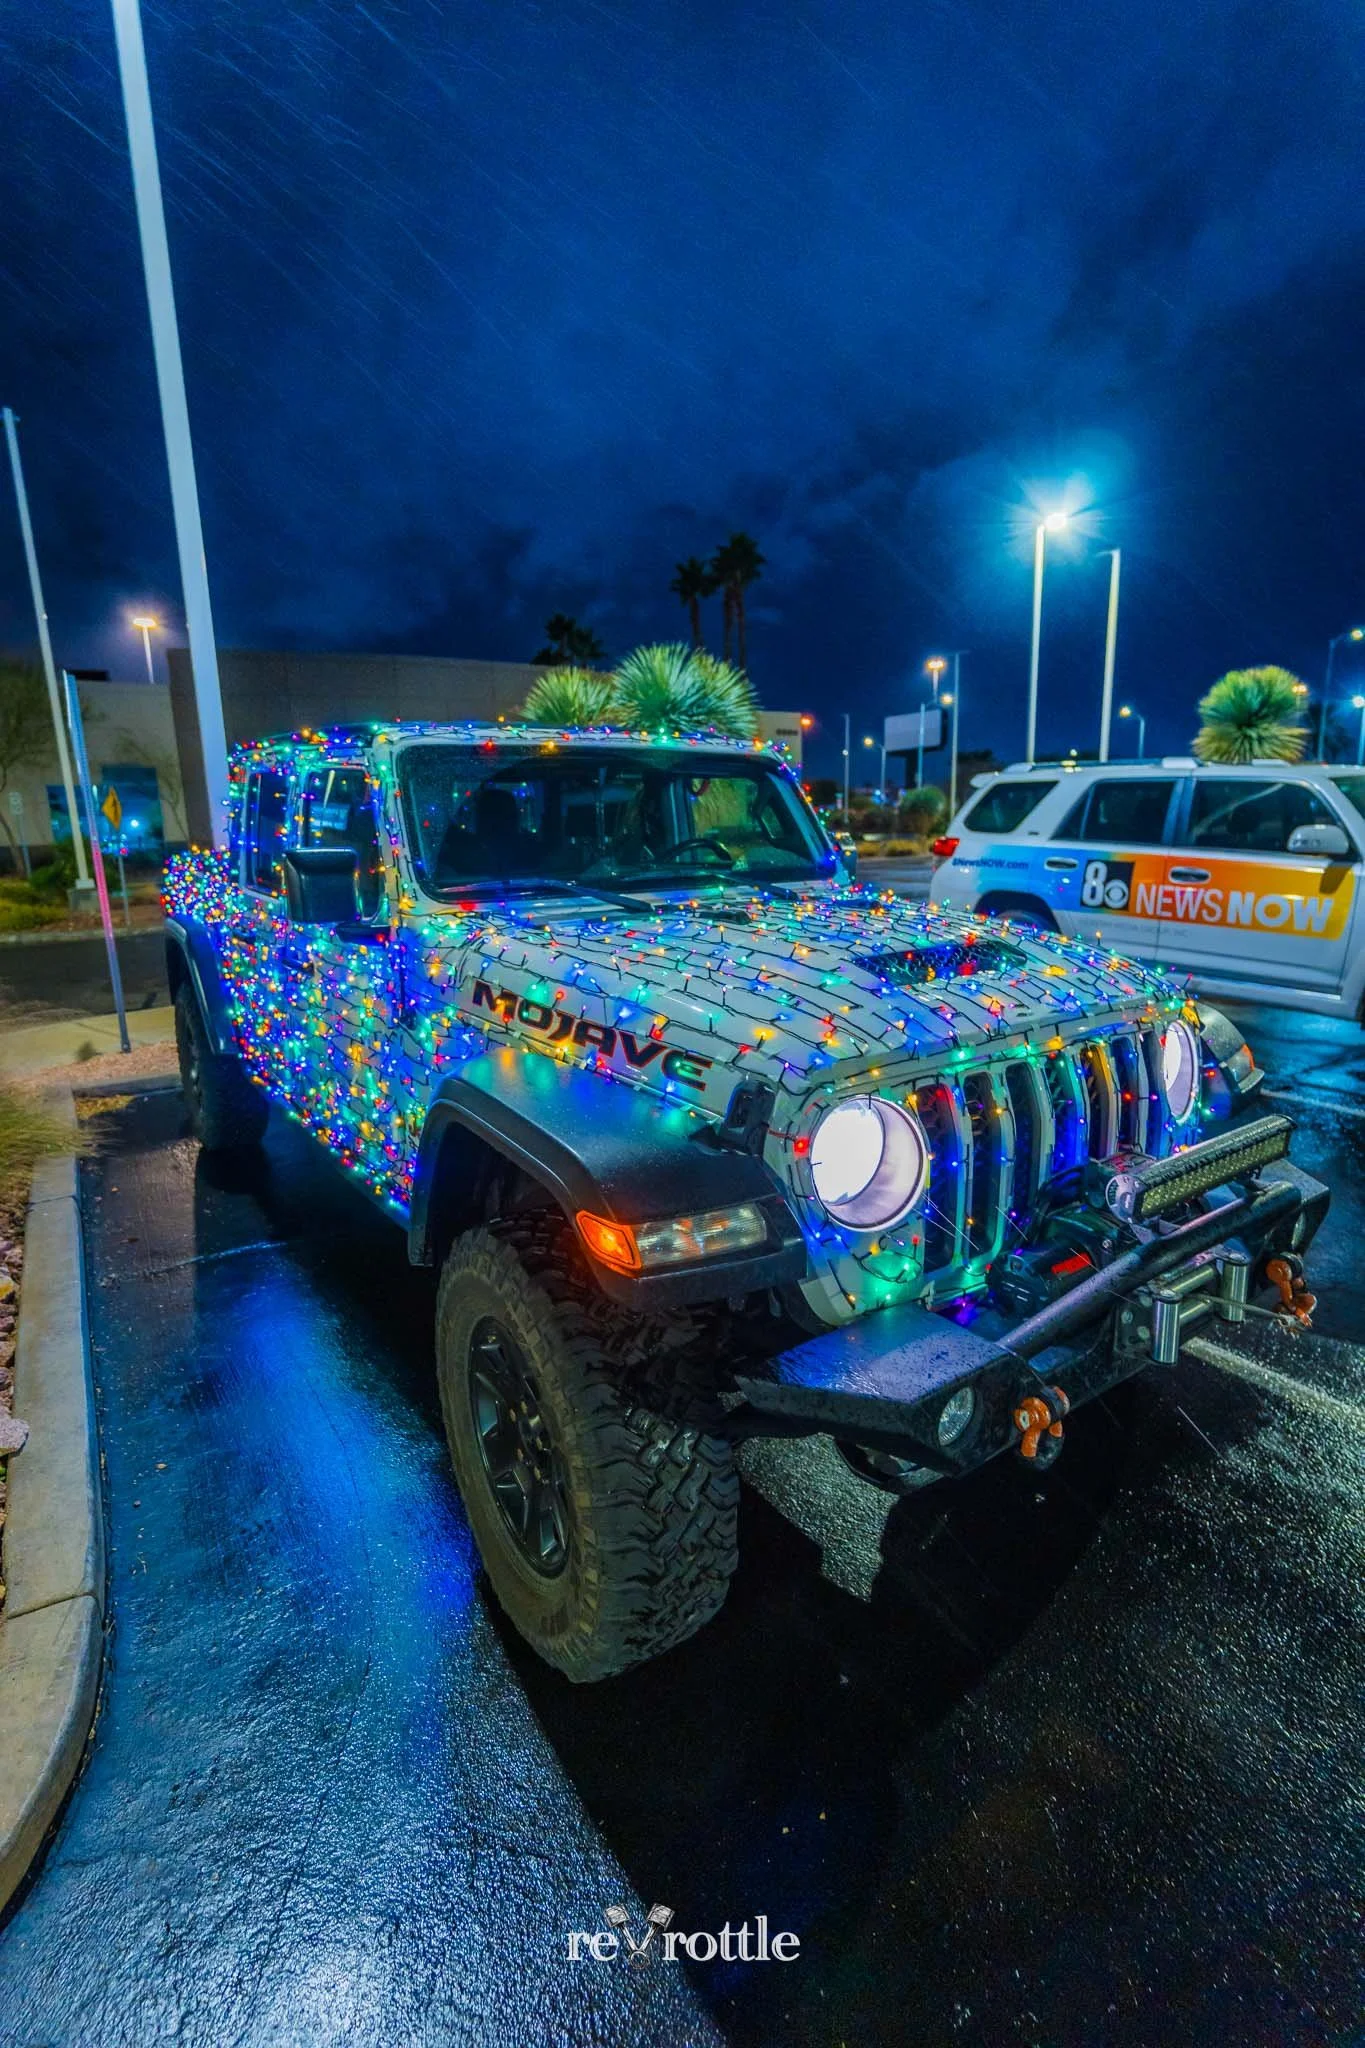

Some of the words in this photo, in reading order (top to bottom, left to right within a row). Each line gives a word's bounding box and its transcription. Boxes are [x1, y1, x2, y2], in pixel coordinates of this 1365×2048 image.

[1082, 861, 1107, 907] 8
[1135, 883, 1224, 923] NEWS
[1226, 891, 1334, 933] NOW
[472, 981, 713, 1091] MOJAVE
